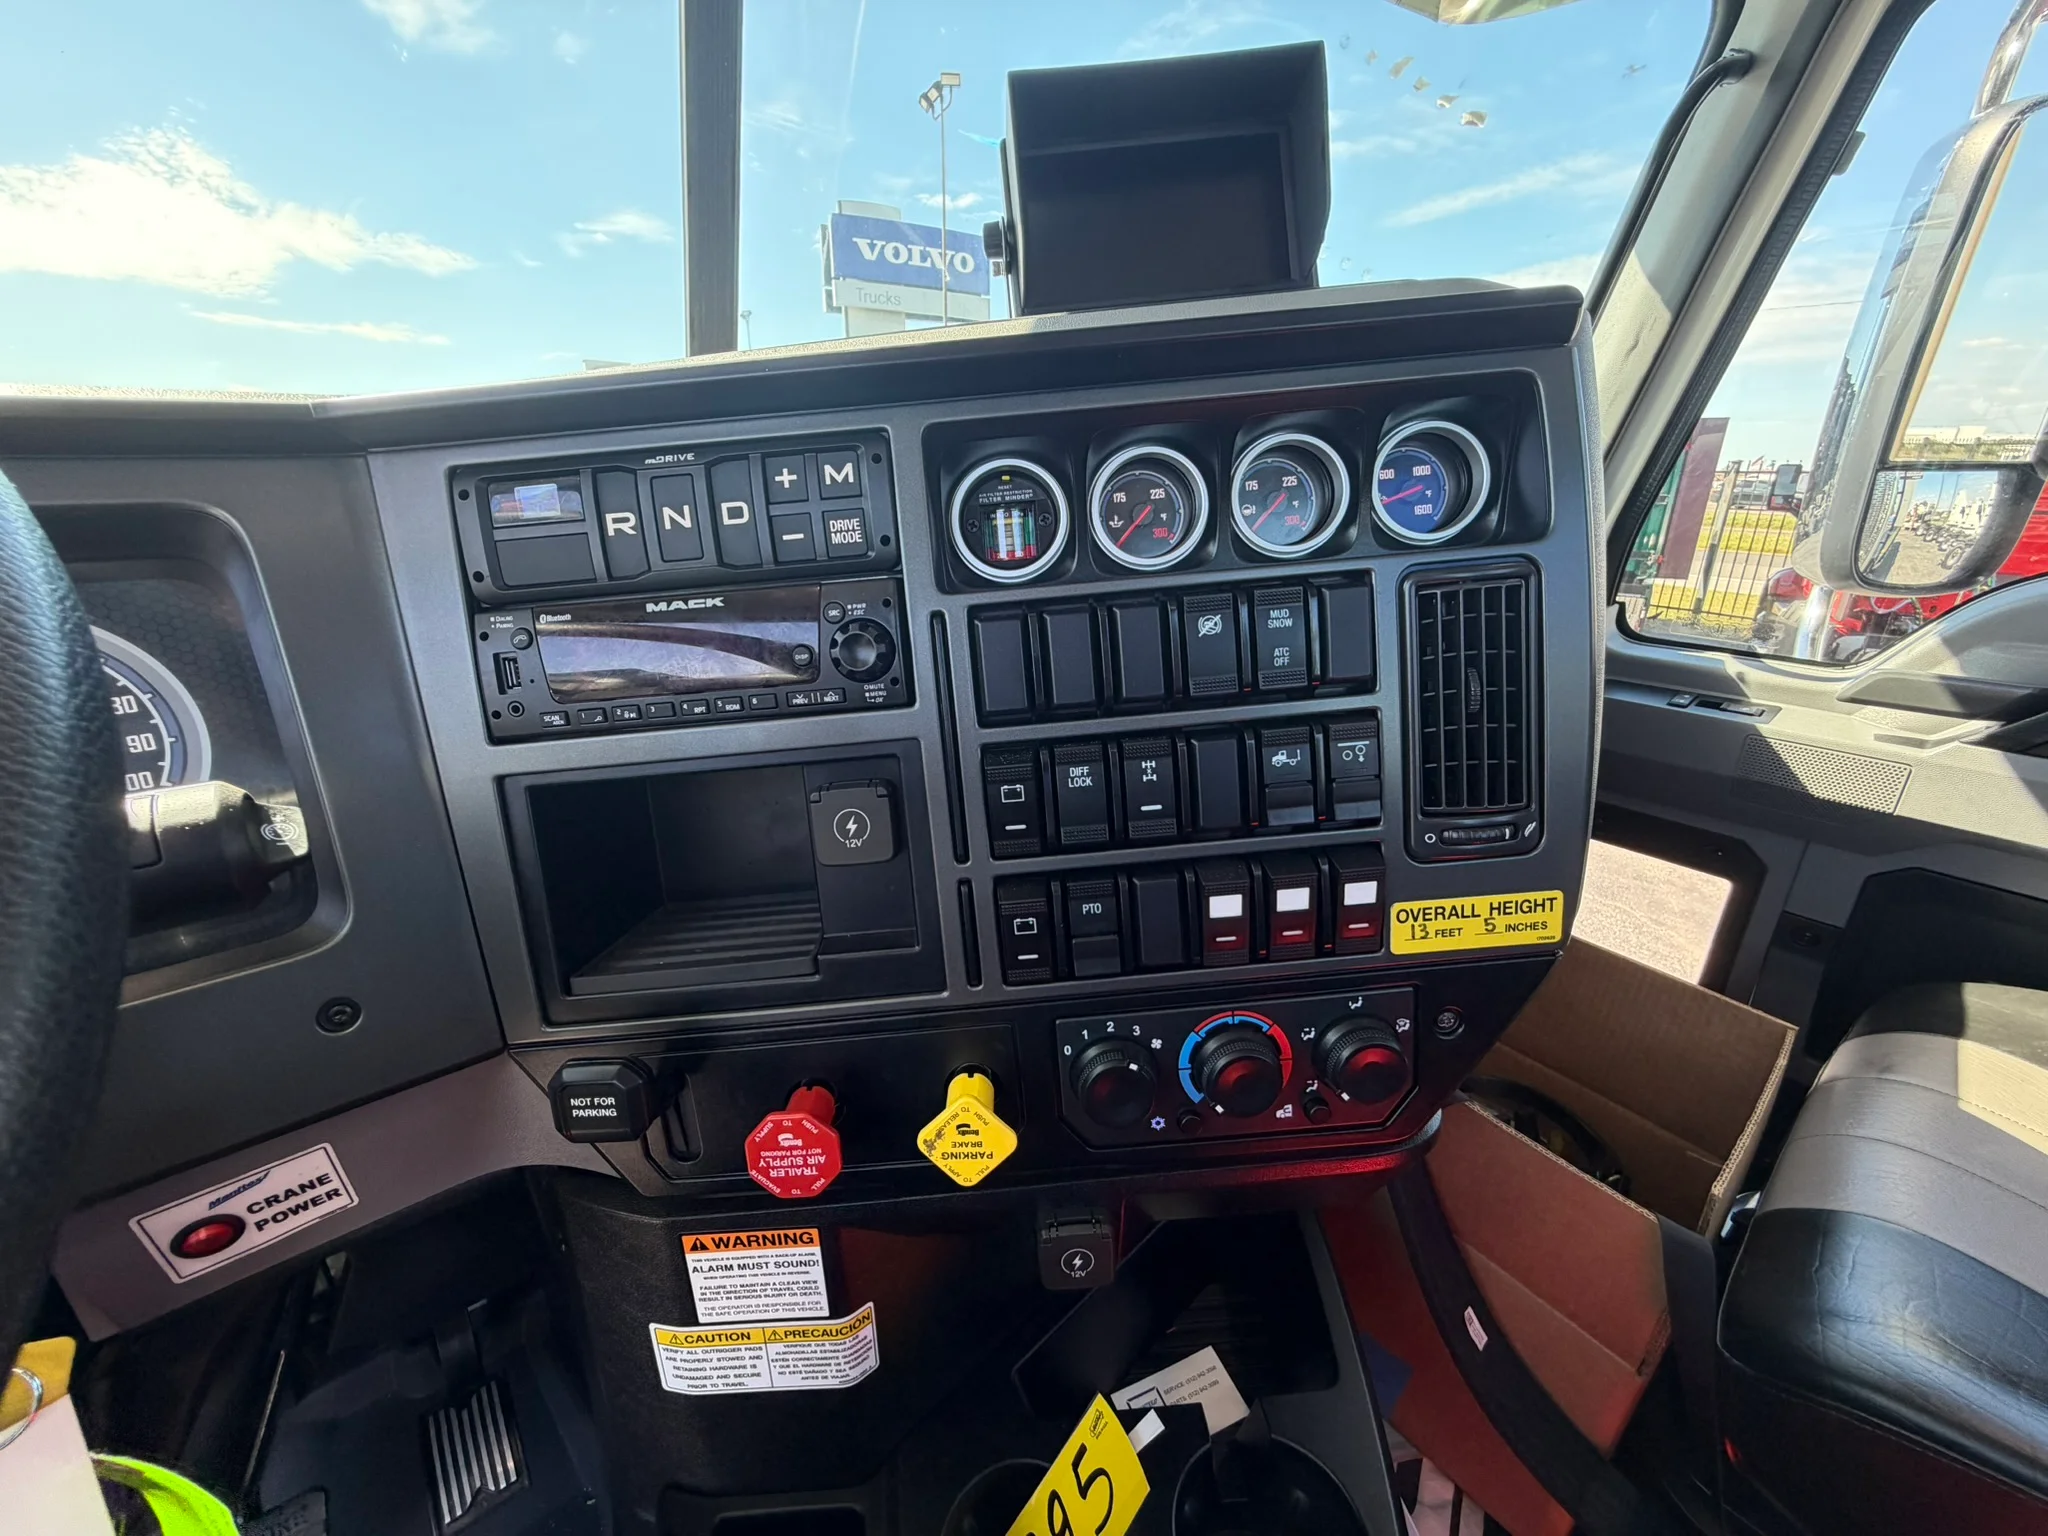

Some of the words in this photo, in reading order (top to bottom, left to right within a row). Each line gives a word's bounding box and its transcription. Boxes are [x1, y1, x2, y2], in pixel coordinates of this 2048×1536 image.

[852, 237, 976, 276] VOLVO
[856, 287, 901, 306] Trucks
[824, 462, 854, 485] M
[1379, 469, 1395, 481] 600
[1412, 465, 1432, 477] 1000
[1245, 480, 1259, 491] 175
[1282, 475, 1298, 487] 225
[1112, 492, 1127, 504] 175
[1150, 488, 1166, 500] 225
[720, 501, 750, 525] D
[1414, 504, 1433, 515] 1600
[606, 510, 637, 537] R
[662, 505, 692, 530] N
[1285, 515, 1301, 526] 300
[829, 518, 861, 531] DRIVE
[831, 530, 863, 544] MODE
[1152, 527, 1168, 538] 300
[646, 597, 725, 613] MACK
[547, 613, 572, 622] Bluetooth
[828, 609, 840, 617] SRC
[1270, 609, 1290, 619] MUD
[1267, 618, 1293, 629] SNOW
[1273, 647, 1290, 657] ATC
[1273, 656, 1290, 667] OFF
[693, 706, 706, 714] RPT
[126, 733, 157, 754] 90
[1069, 766, 1090, 778] DIFF
[1068, 775, 1093, 788] LOCK
[845, 838, 863, 848] 12V
[1082, 903, 1102, 915] PTO
[1396, 904, 1481, 924] OVERALL
[1489, 897, 1558, 917] HEIGHT
[1411, 923, 1430, 940] 13
[1435, 927, 1463, 938] FEET
[1483, 917, 1497, 934] 5
[1504, 921, 1548, 933] INCHES
[1106, 1021, 1115, 1033] 2
[1132, 1025, 1141, 1036] 3
[1081, 1029, 1089, 1041] 1
[1064, 1044, 1072, 1056] 0
[570, 1098, 591, 1106] NOT
[594, 1097, 616, 1106] FOR
[572, 1108, 617, 1117] PARKING
[973, 1111, 990, 1126] PUSH
[754, 1121, 774, 1143] SUPPLY
[801, 1120, 819, 1134] PUSH
[806, 1155, 826, 1164] AIR
[941, 1151, 994, 1160] PARKING
[759, 1157, 804, 1167] SUPPLY
[769, 1166, 819, 1177] TRAILER
[943, 1163, 962, 1178] APPLY
[975, 1165, 990, 1177] PULL
[751, 1169, 781, 1194] EVACUATE
[811, 1177, 826, 1190] PULL
[246, 1172, 334, 1215] CRANE
[253, 1187, 343, 1232] POWER
[711, 1232, 814, 1249] WARNING
[692, 1264, 734, 1274] ALARM
[737, 1262, 770, 1271] MUST
[774, 1260, 820, 1269] SOUND!
[1070, 1270, 1088, 1278] 12V
[784, 1312, 870, 1339] PRECAUCIÓN
[684, 1332, 751, 1344] CAUTION
[1163, 1383, 1185, 1396] SERVICE
